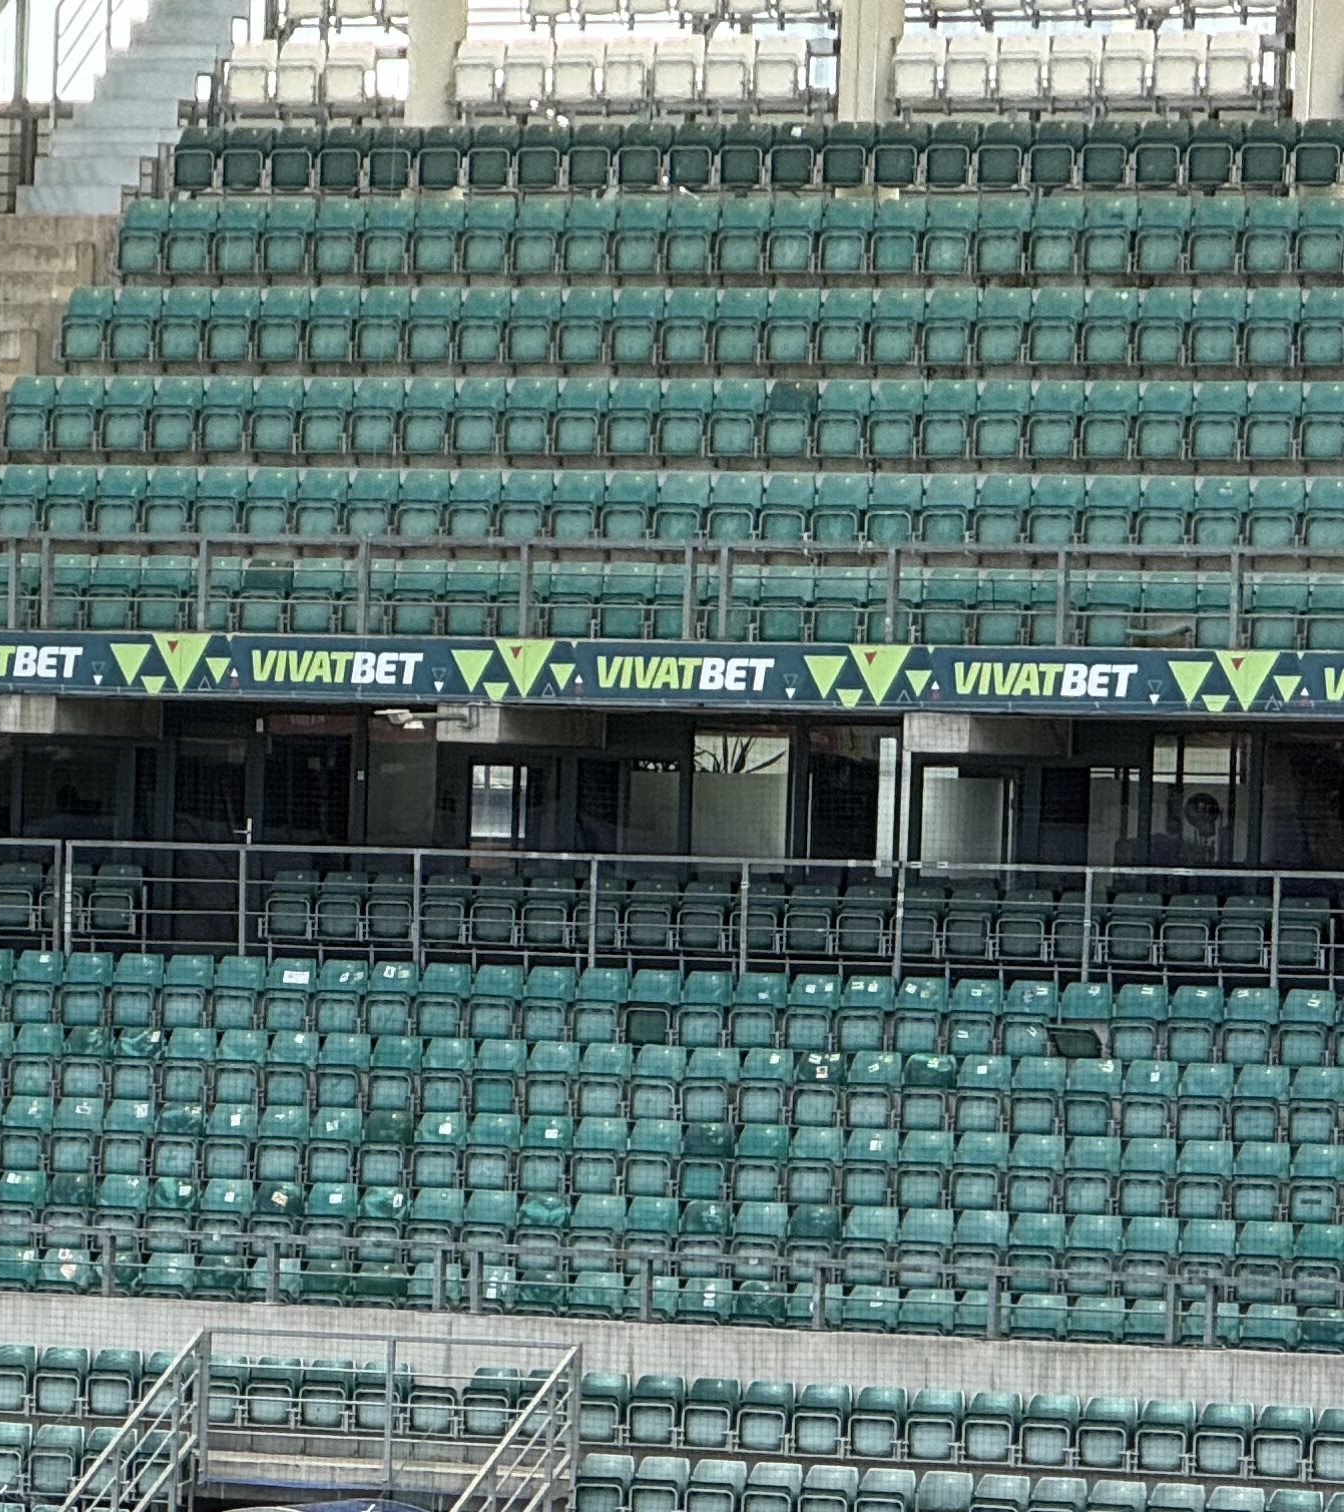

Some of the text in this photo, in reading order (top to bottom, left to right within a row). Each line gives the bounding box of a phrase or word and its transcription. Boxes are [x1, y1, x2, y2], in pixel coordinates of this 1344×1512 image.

[251, 649, 424, 685] VIVATBET
[596, 655, 775, 692] VIVATBET
[954, 661, 1139, 698] VIVATBET
